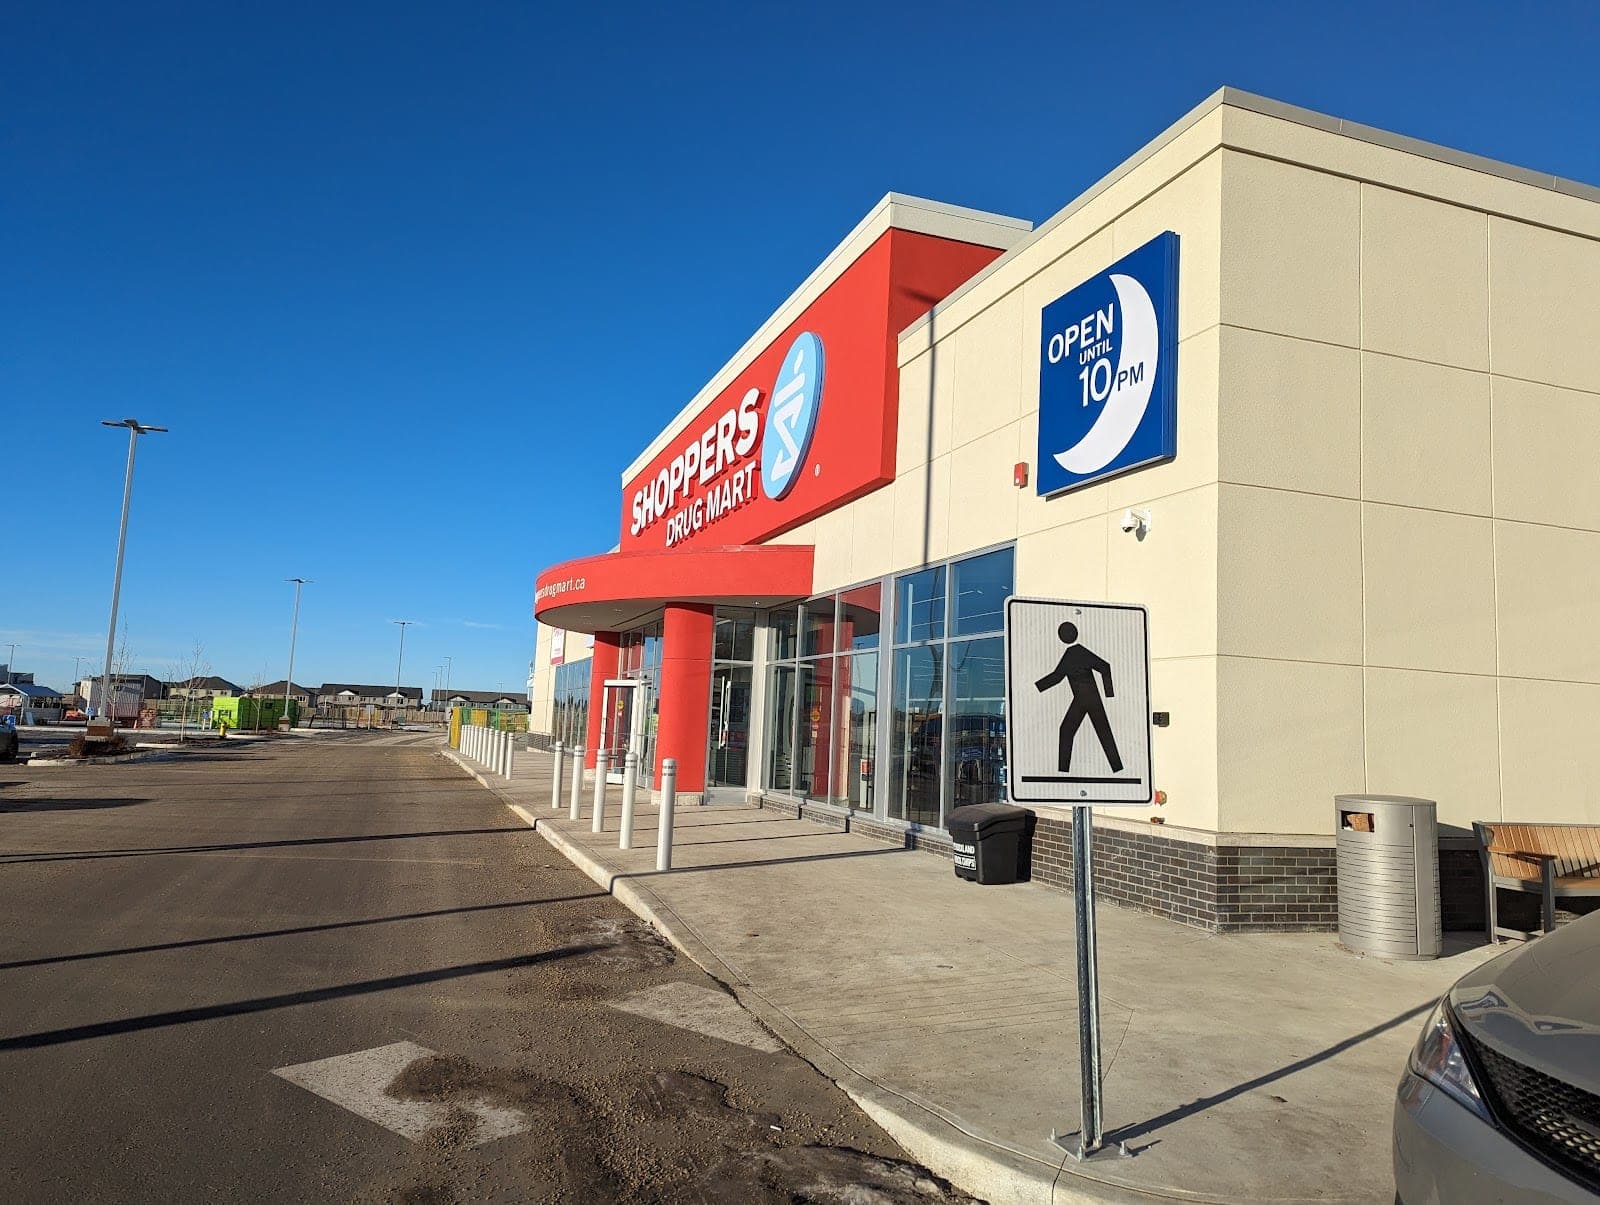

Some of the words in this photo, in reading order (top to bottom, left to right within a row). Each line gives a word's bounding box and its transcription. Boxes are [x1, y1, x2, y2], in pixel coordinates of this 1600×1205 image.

[1048, 303, 1114, 364] OPEN
[1079, 338, 1113, 365] UNTIL
[1079, 357, 1112, 408] 10
[1117, 361, 1144, 392] PM
[630, 387, 760, 536] SHOPPERS
[665, 497, 703, 547] DRUG
[706, 460, 757, 523] MART
